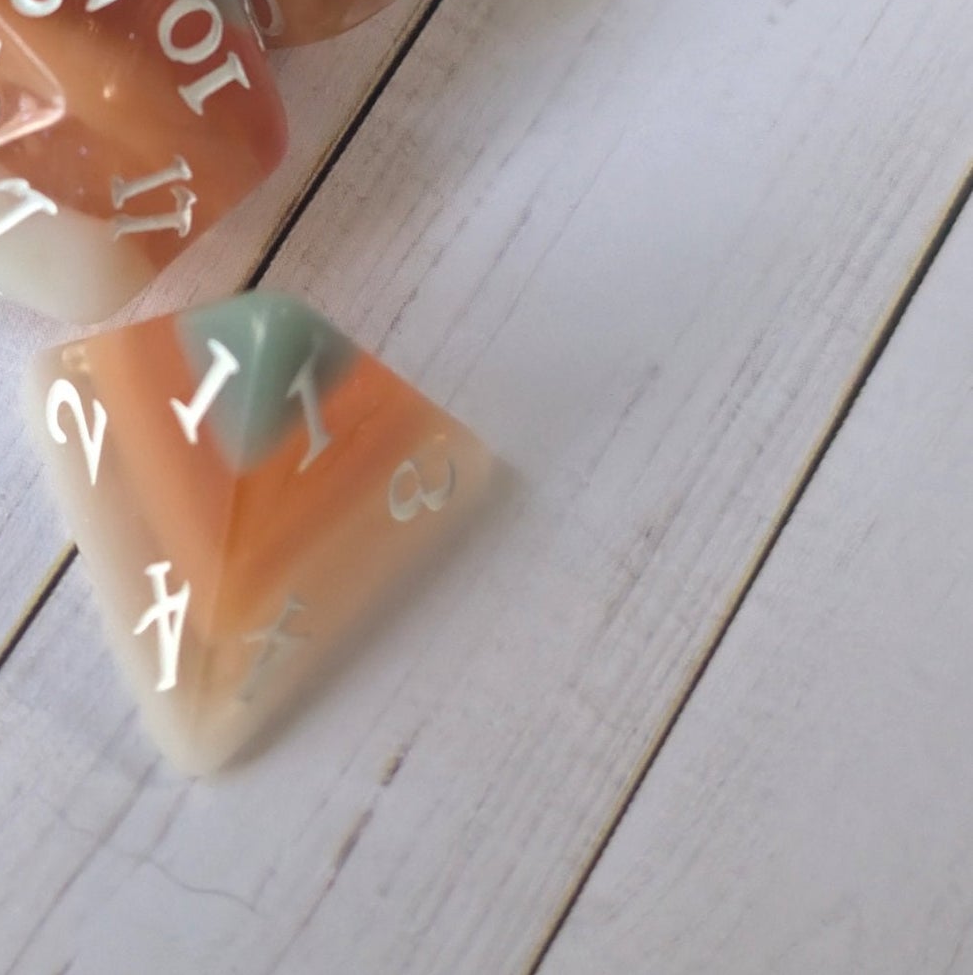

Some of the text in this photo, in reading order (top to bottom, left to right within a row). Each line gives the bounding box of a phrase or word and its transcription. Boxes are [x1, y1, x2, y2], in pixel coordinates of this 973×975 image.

[45, 378, 108, 487] 2
[170, 338, 240, 445] 1
[133, 561, 191, 693] 4
